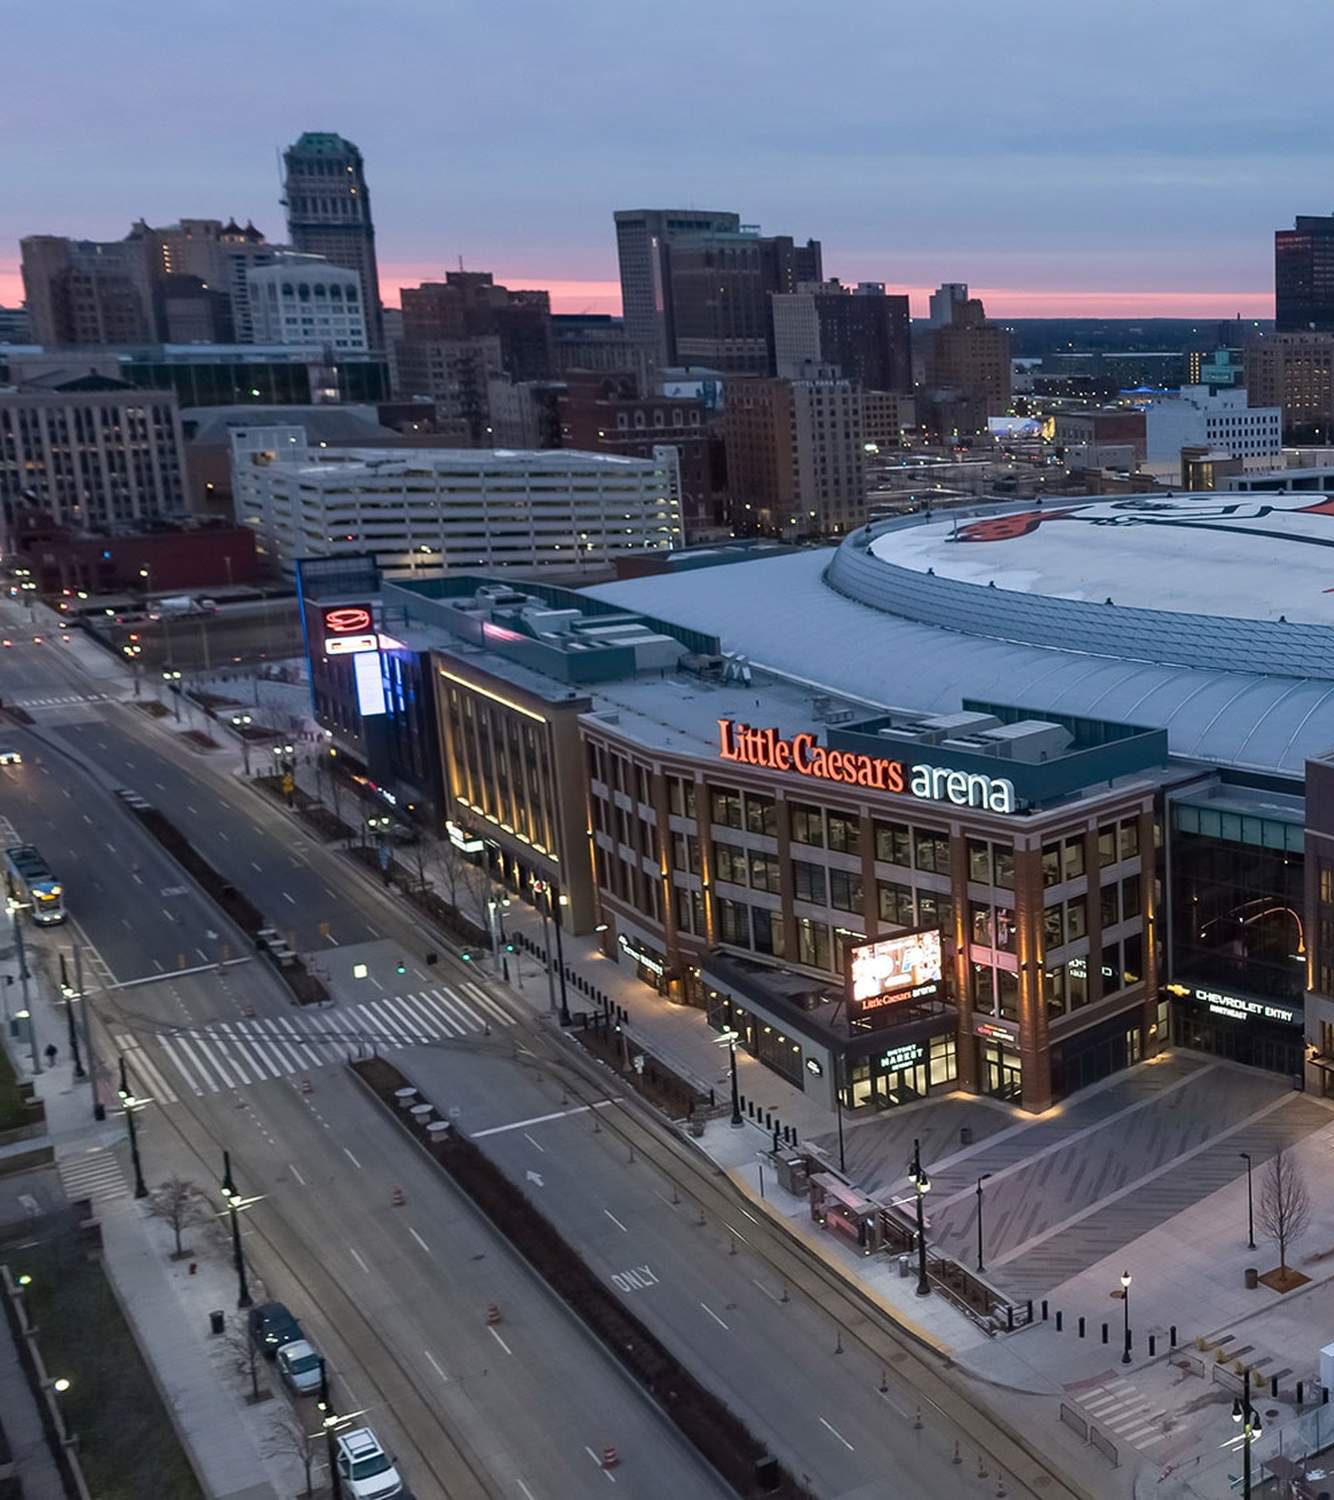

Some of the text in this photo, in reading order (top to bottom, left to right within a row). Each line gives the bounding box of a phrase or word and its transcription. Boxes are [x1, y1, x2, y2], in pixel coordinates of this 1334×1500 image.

[716, 719, 1013, 814] Little Caesars arena
[862, 984, 937, 1011] Little Caesars arena
[1195, 989, 1293, 1021] CHEVROLET ENTRY
[880, 1047, 924, 1067] MARKET
[611, 1264, 660, 1293] ONLY
